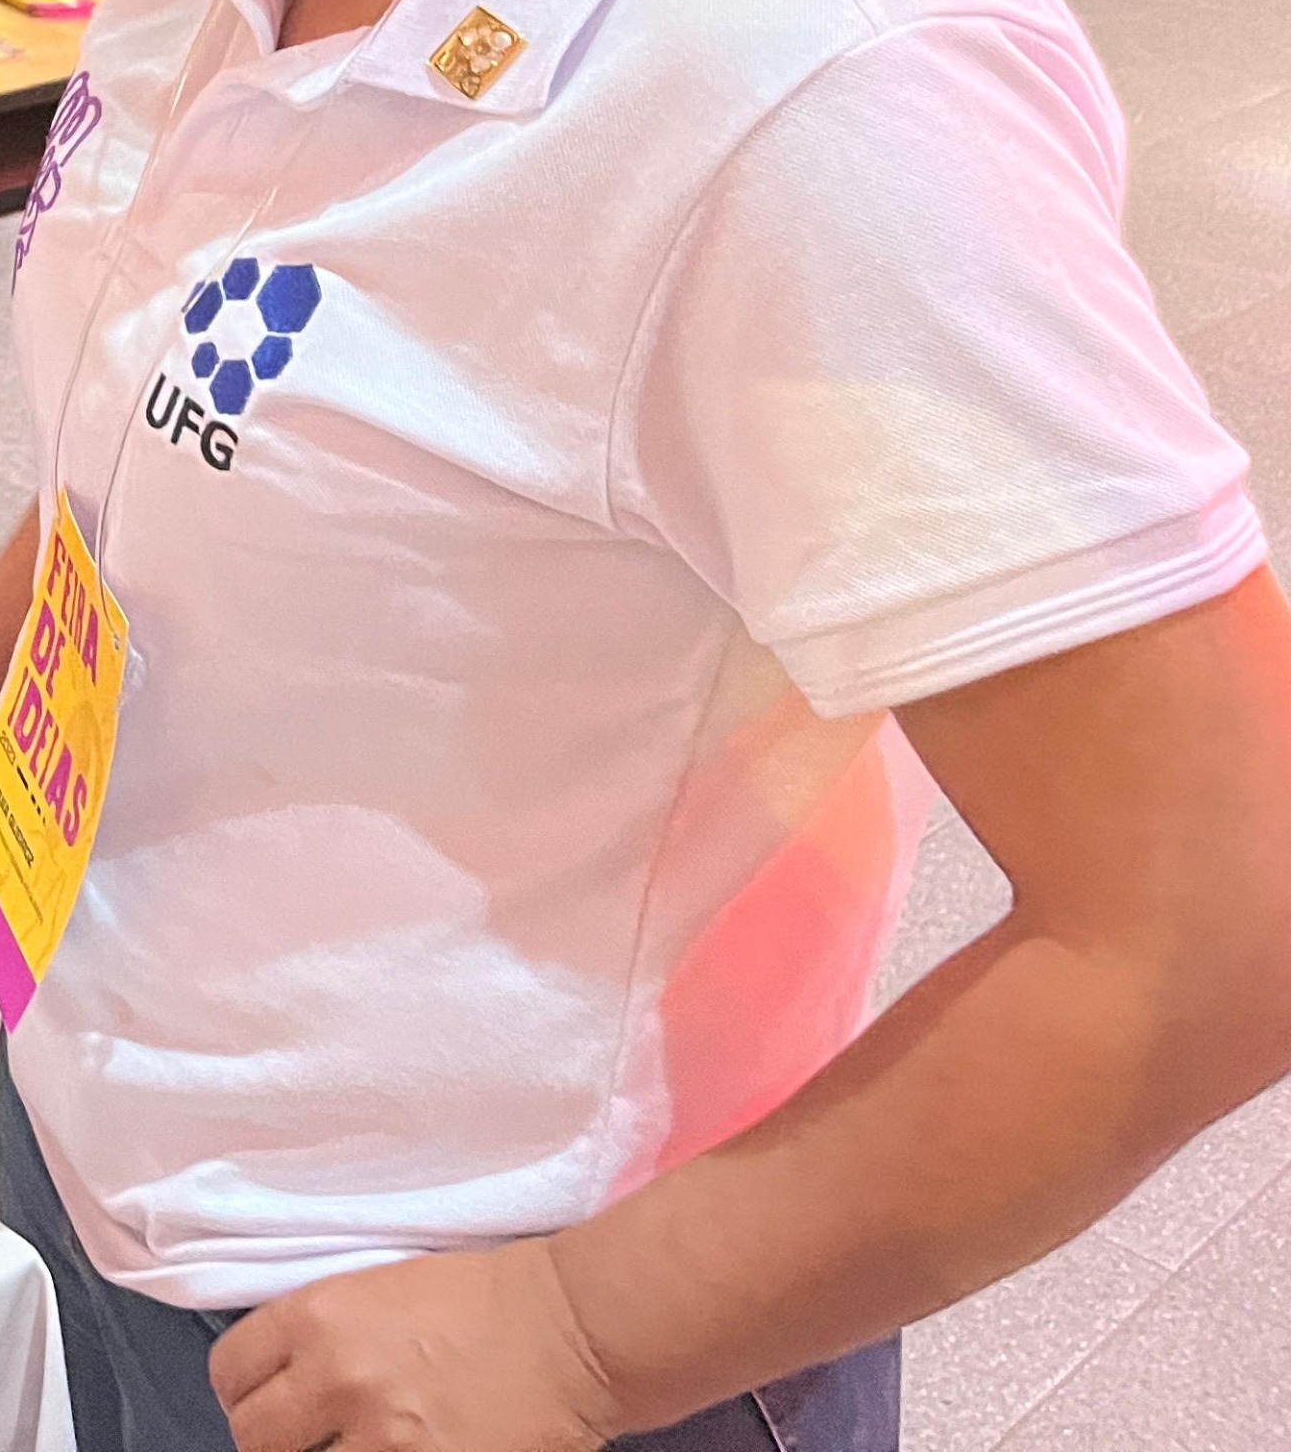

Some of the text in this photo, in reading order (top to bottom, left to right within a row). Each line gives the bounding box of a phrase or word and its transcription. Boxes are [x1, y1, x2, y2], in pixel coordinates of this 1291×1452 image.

[146, 372, 239, 471] UFG
[30, 598, 66, 700] DE
[47, 532, 99, 687] FEIRA
[7, 665, 87, 848] IDEIAS
